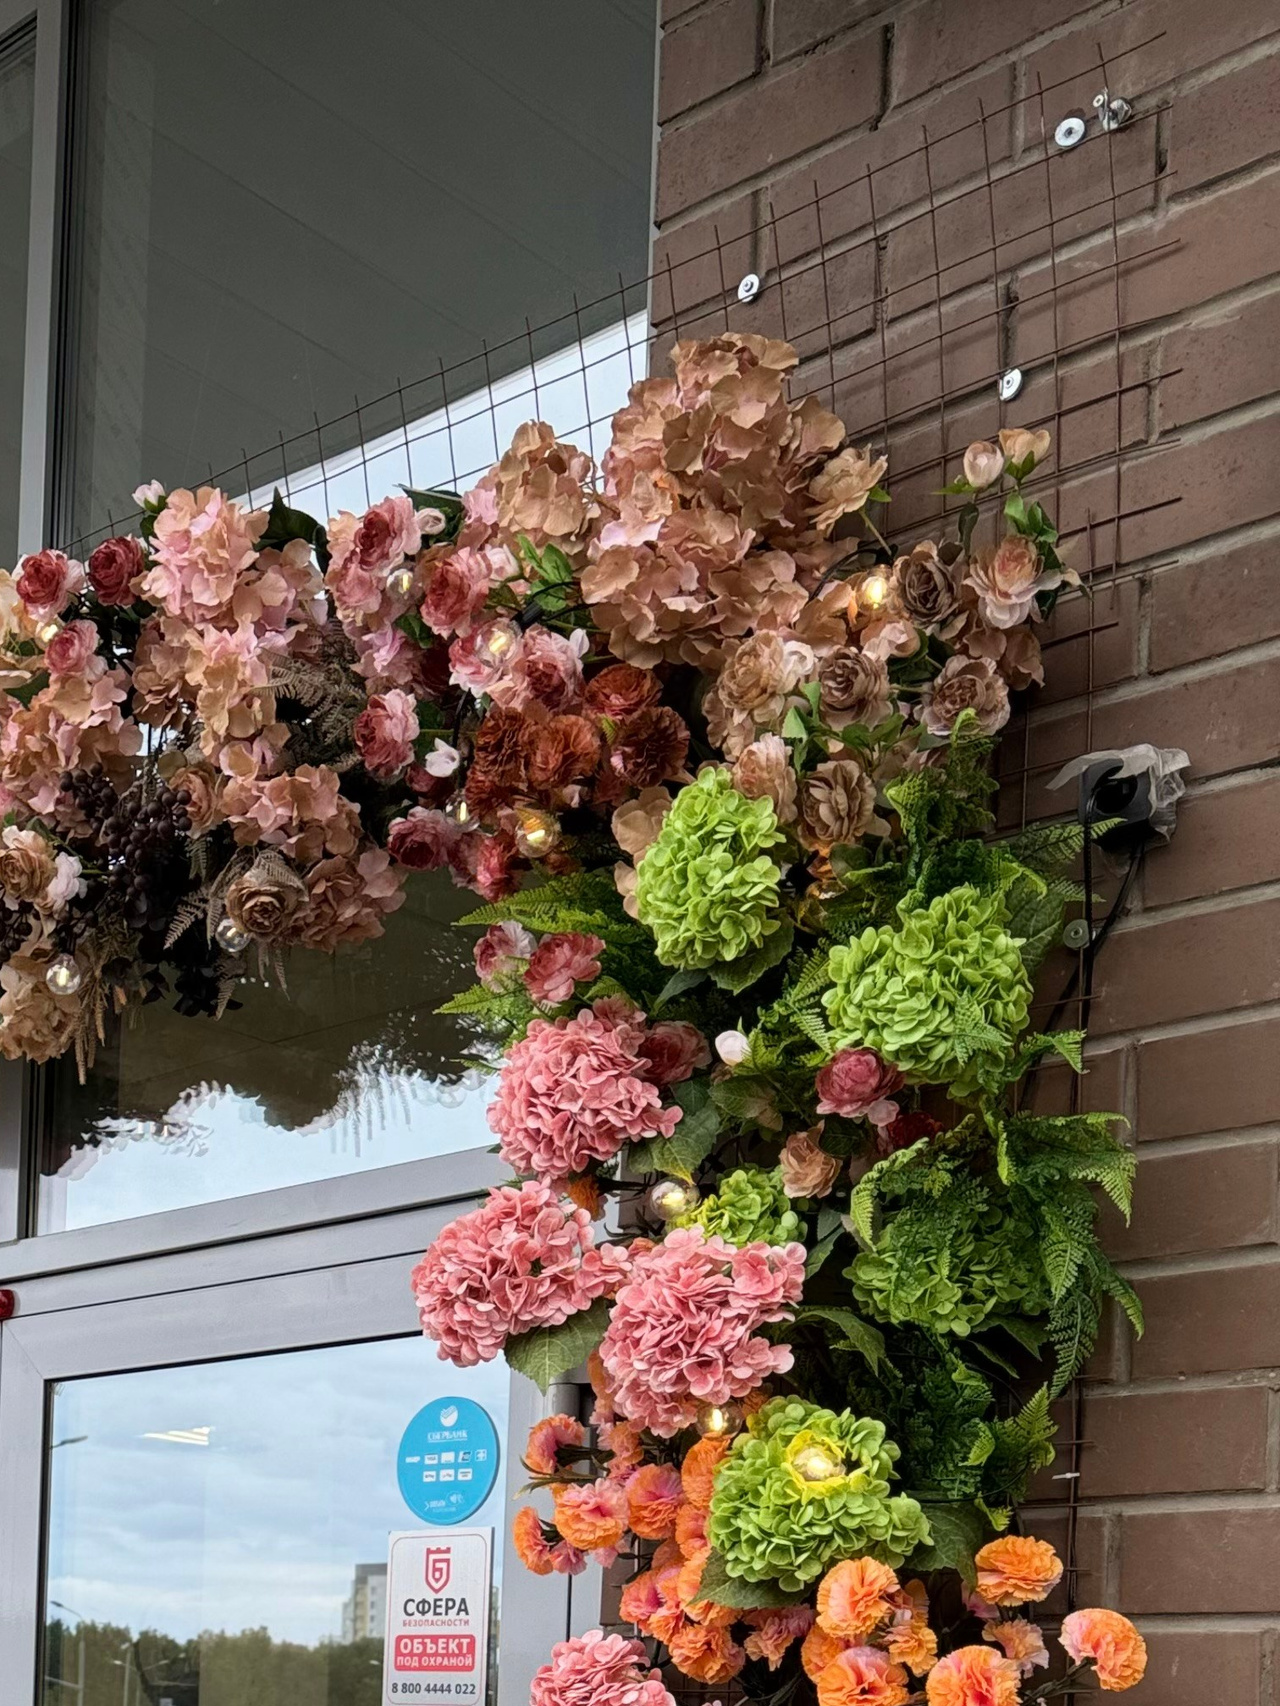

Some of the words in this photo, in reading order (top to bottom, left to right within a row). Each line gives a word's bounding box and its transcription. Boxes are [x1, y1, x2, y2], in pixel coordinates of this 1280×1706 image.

[403, 1597, 469, 1617] СФЕРА
[402, 1619, 470, 1628] БЕЗОПАСНОСТИ
[400, 1638, 470, 1654] ОБЪЕКТ
[396, 1656, 419, 1668] ПОД
[421, 1654, 473, 1667] ОХРАНОЙ
[391, 1682, 399, 1694] 8
[401, 1682, 421, 1694] 800
[424, 1683, 452, 1694] 4444
[455, 1683, 476, 1695] 022
